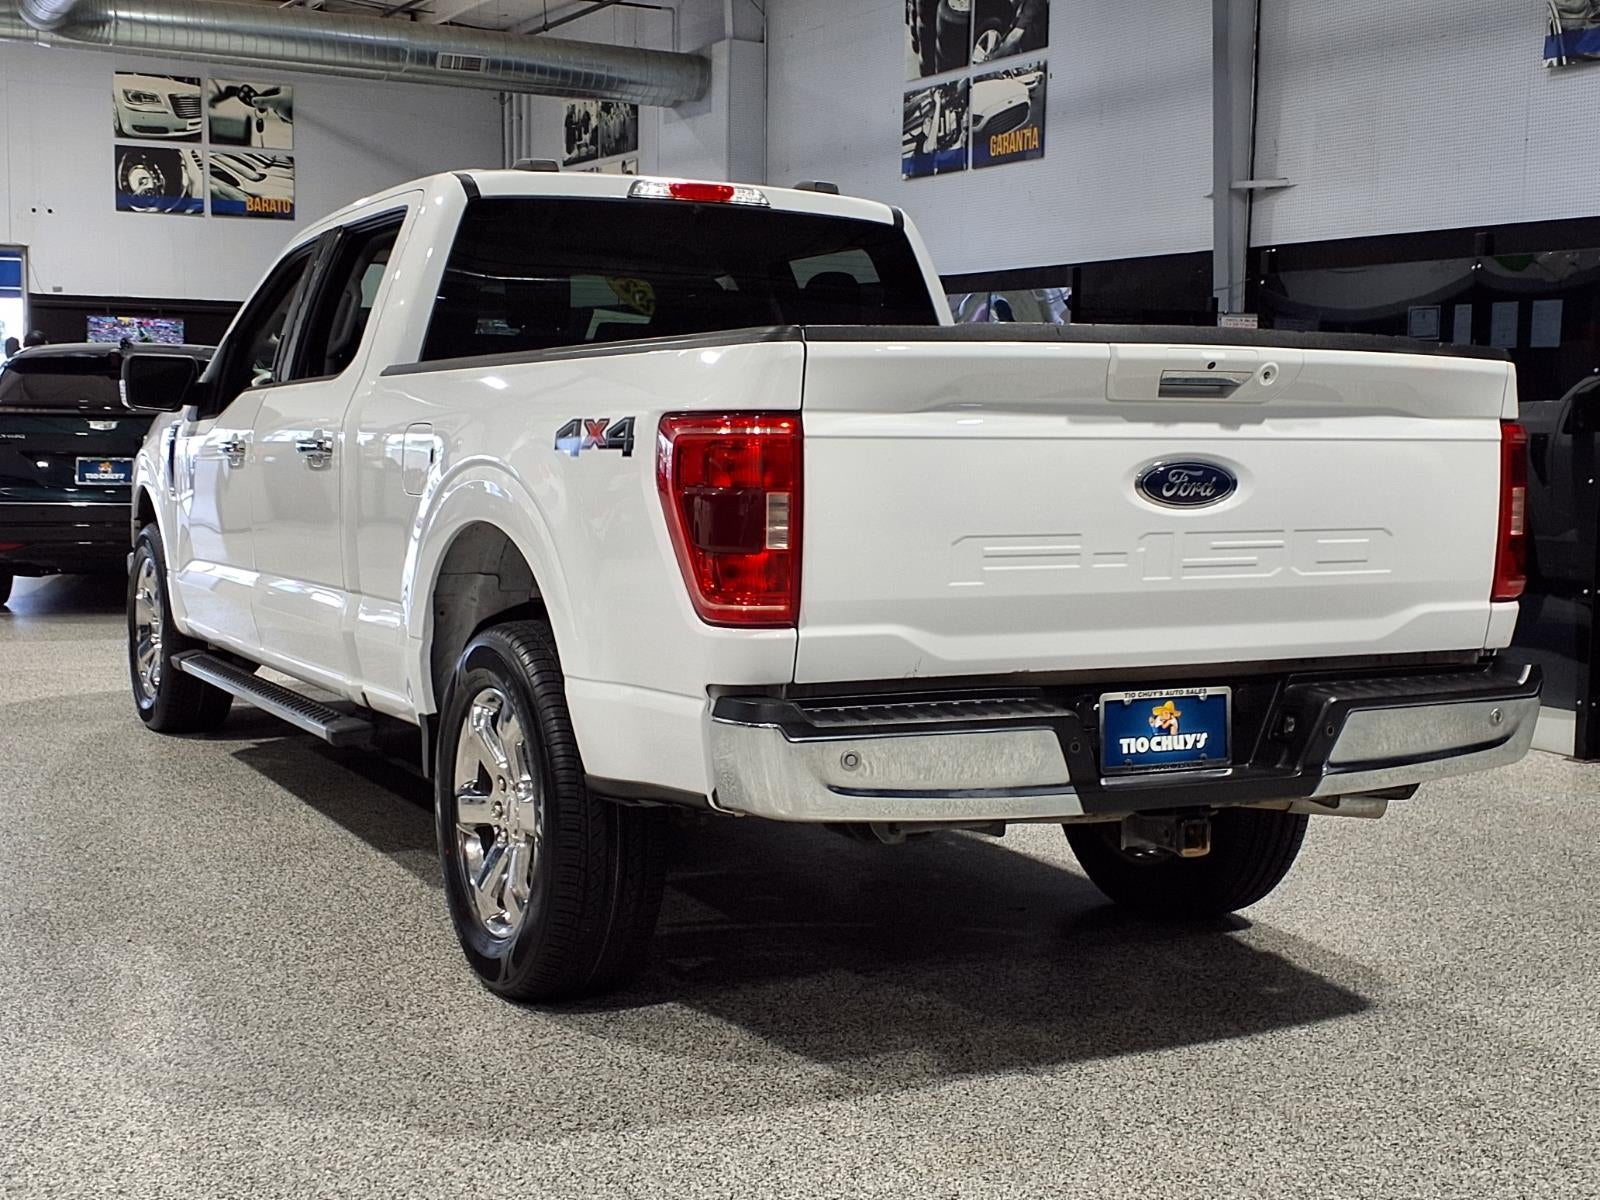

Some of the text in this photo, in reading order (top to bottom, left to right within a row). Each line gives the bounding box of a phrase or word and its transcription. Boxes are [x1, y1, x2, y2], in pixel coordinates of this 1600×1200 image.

[990, 124, 1039, 157] GARANTÍA
[246, 196, 291, 214] BARATO
[1162, 469, 1217, 498] Ford
[1186, 687, 1208, 695] SALES
